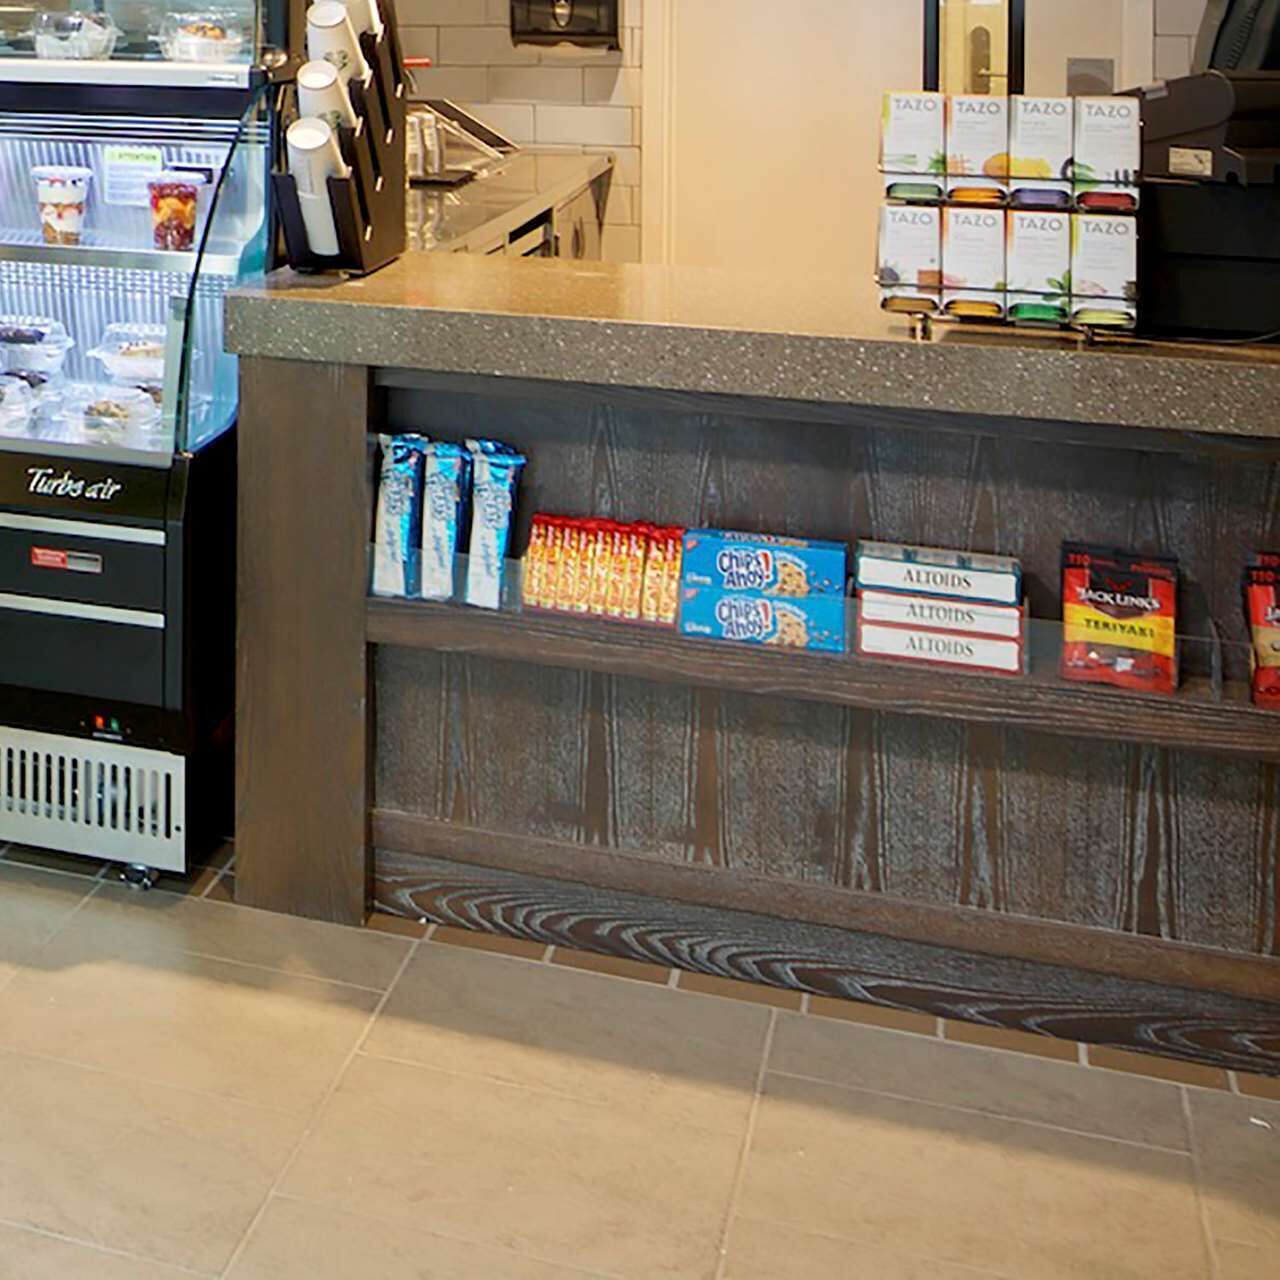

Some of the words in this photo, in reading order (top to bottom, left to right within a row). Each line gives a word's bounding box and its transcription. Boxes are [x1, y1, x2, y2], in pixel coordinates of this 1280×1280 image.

[894, 99, 938, 111] TAZO
[956, 101, 1000, 114] TAZO
[1022, 101, 1066, 116] TAZO
[1085, 104, 1131, 118] TAZO
[889, 211, 933, 225] TAZO
[953, 213, 997, 228] TAZO
[1017, 216, 1063, 231] TAZO
[1083, 221, 1129, 235] TAZO
[27, 468, 85, 497] Turbo
[85, 478, 122, 500] air
[719, 551, 762, 573] Chips
[904, 569, 972, 589] ALTOIDS
[1075, 586, 1115, 606] JACK
[718, 601, 761, 623] Chips
[906, 603, 976, 624] ALTOIDS
[1084, 618, 1155, 638] TERIYAKI
[906, 636, 975, 657] ALTOIDS
